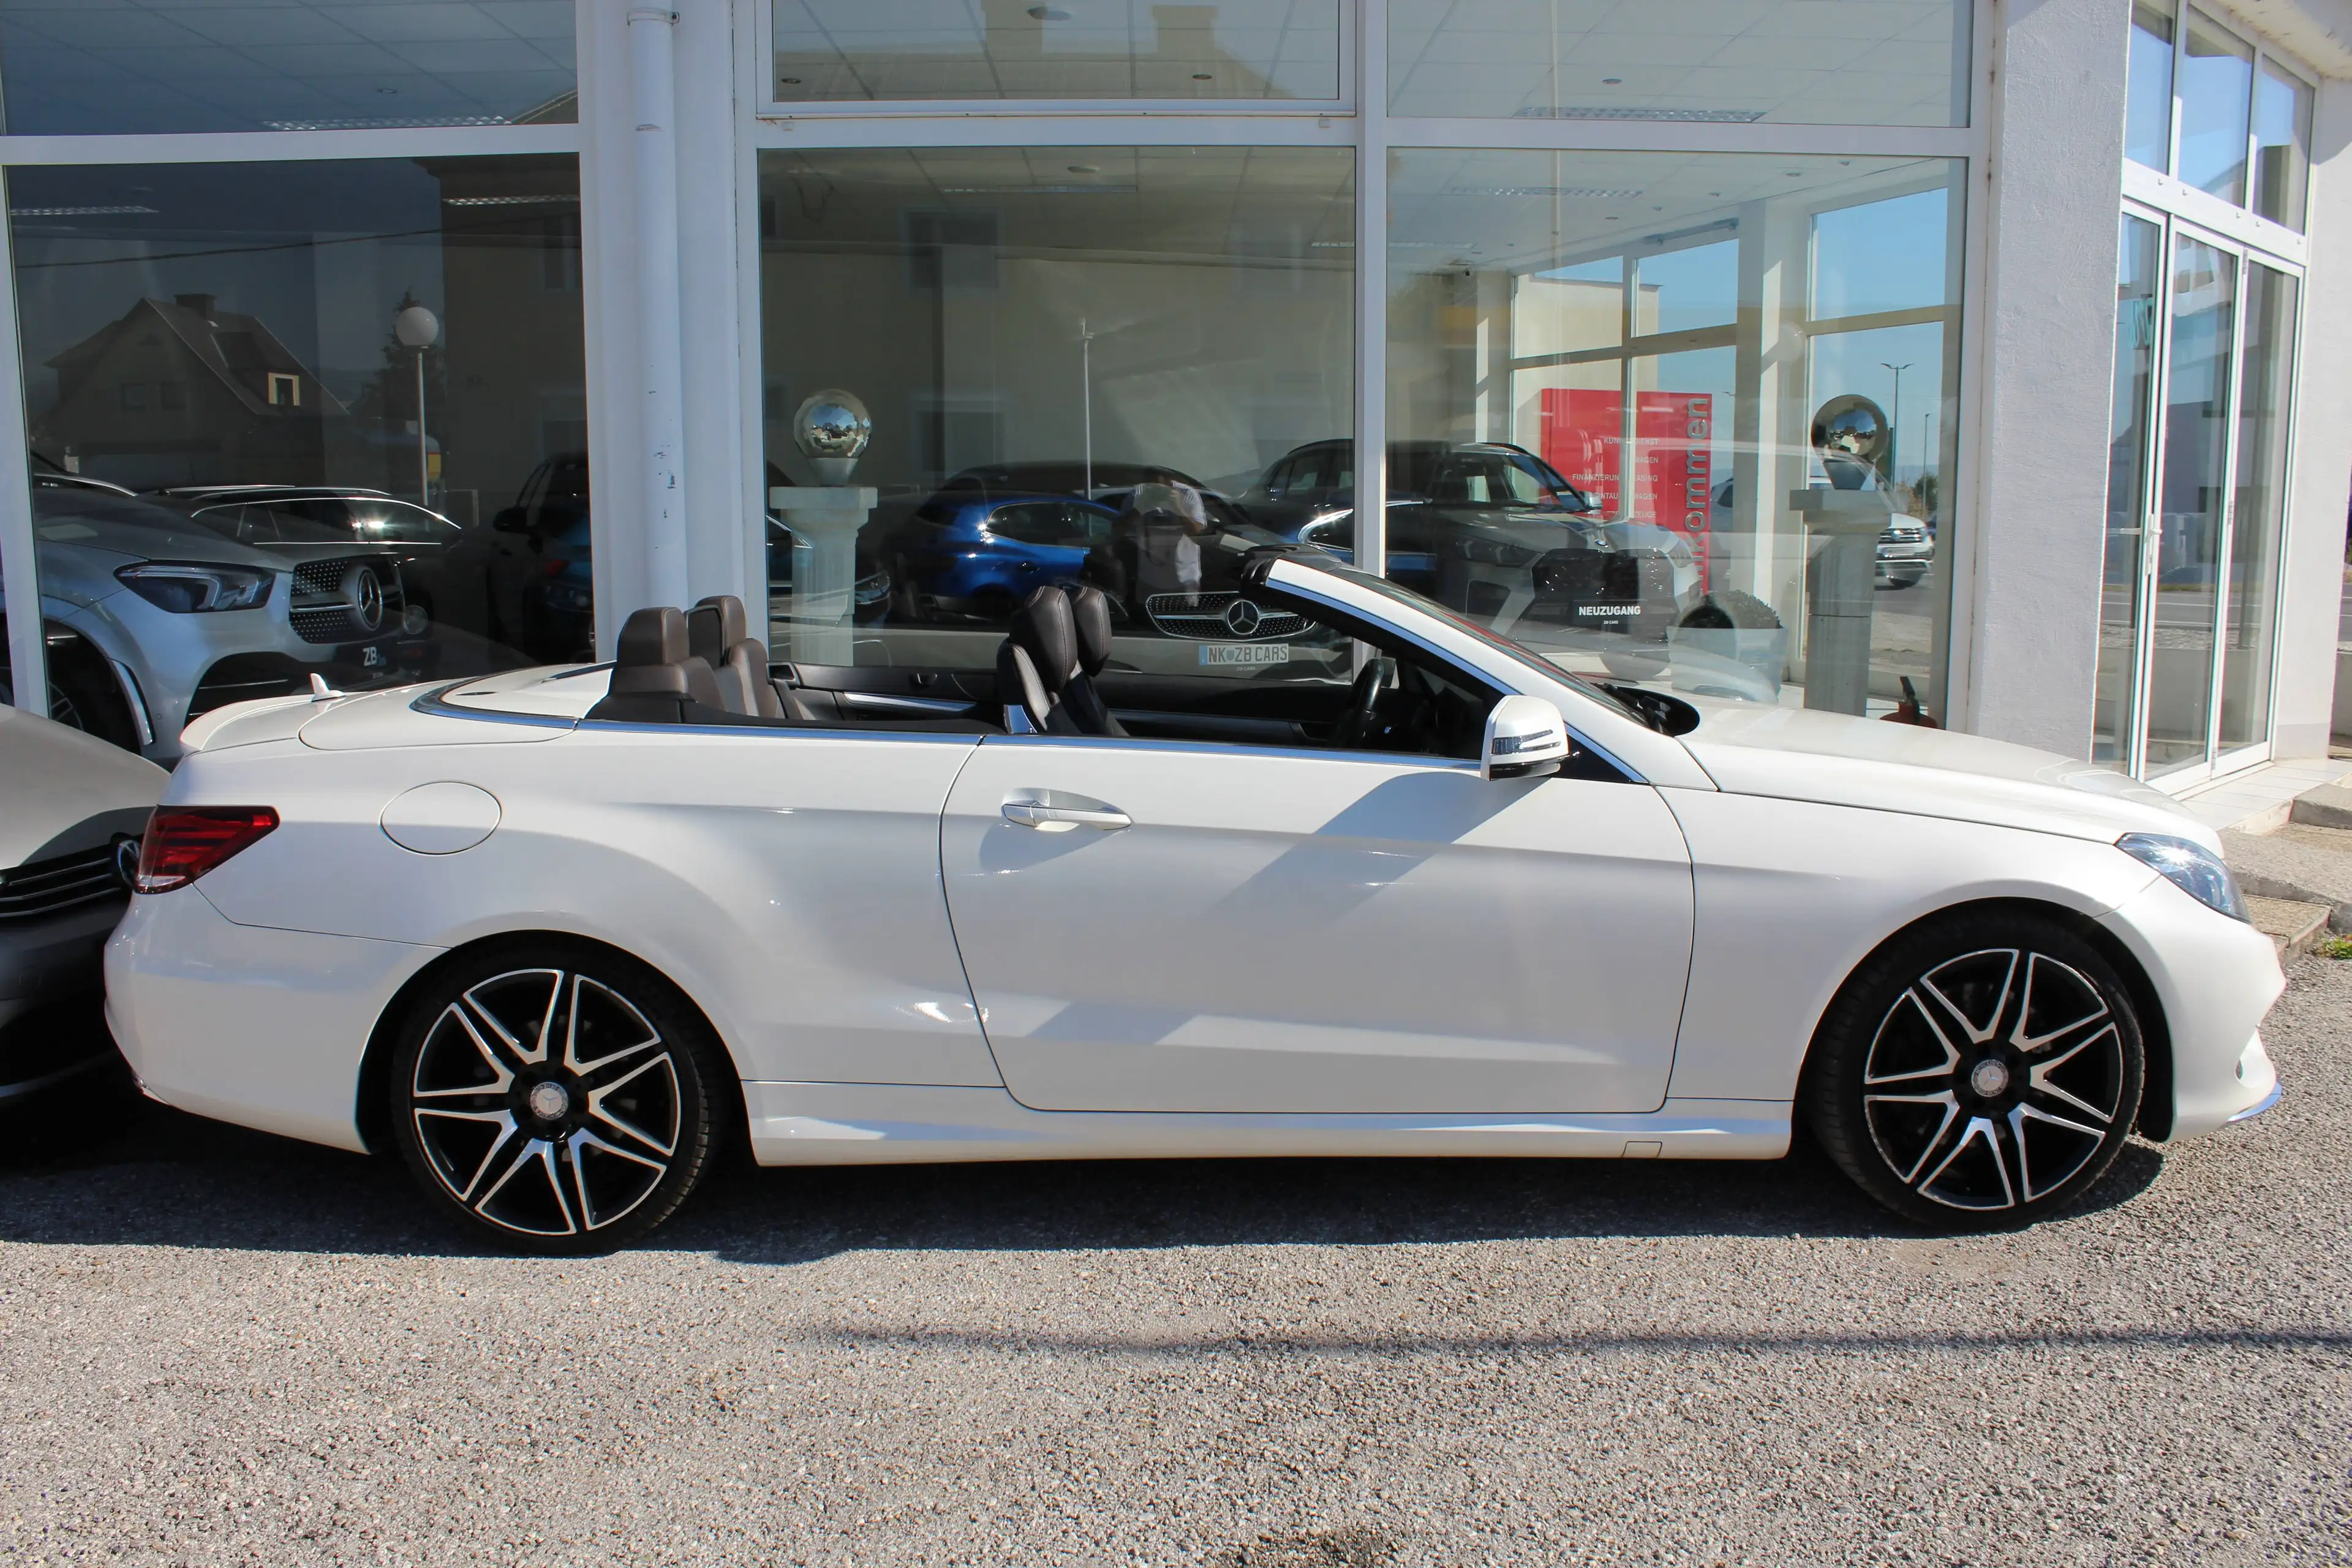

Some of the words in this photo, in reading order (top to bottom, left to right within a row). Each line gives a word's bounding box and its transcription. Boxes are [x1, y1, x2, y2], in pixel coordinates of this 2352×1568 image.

[1578, 606, 1641, 616] NEUZUGANG
[363, 646, 377, 666] ZB
[1208, 647, 1226, 663] NK
[1235, 647, 1251, 662] ZB
[1255, 646, 1287, 662] CARS
